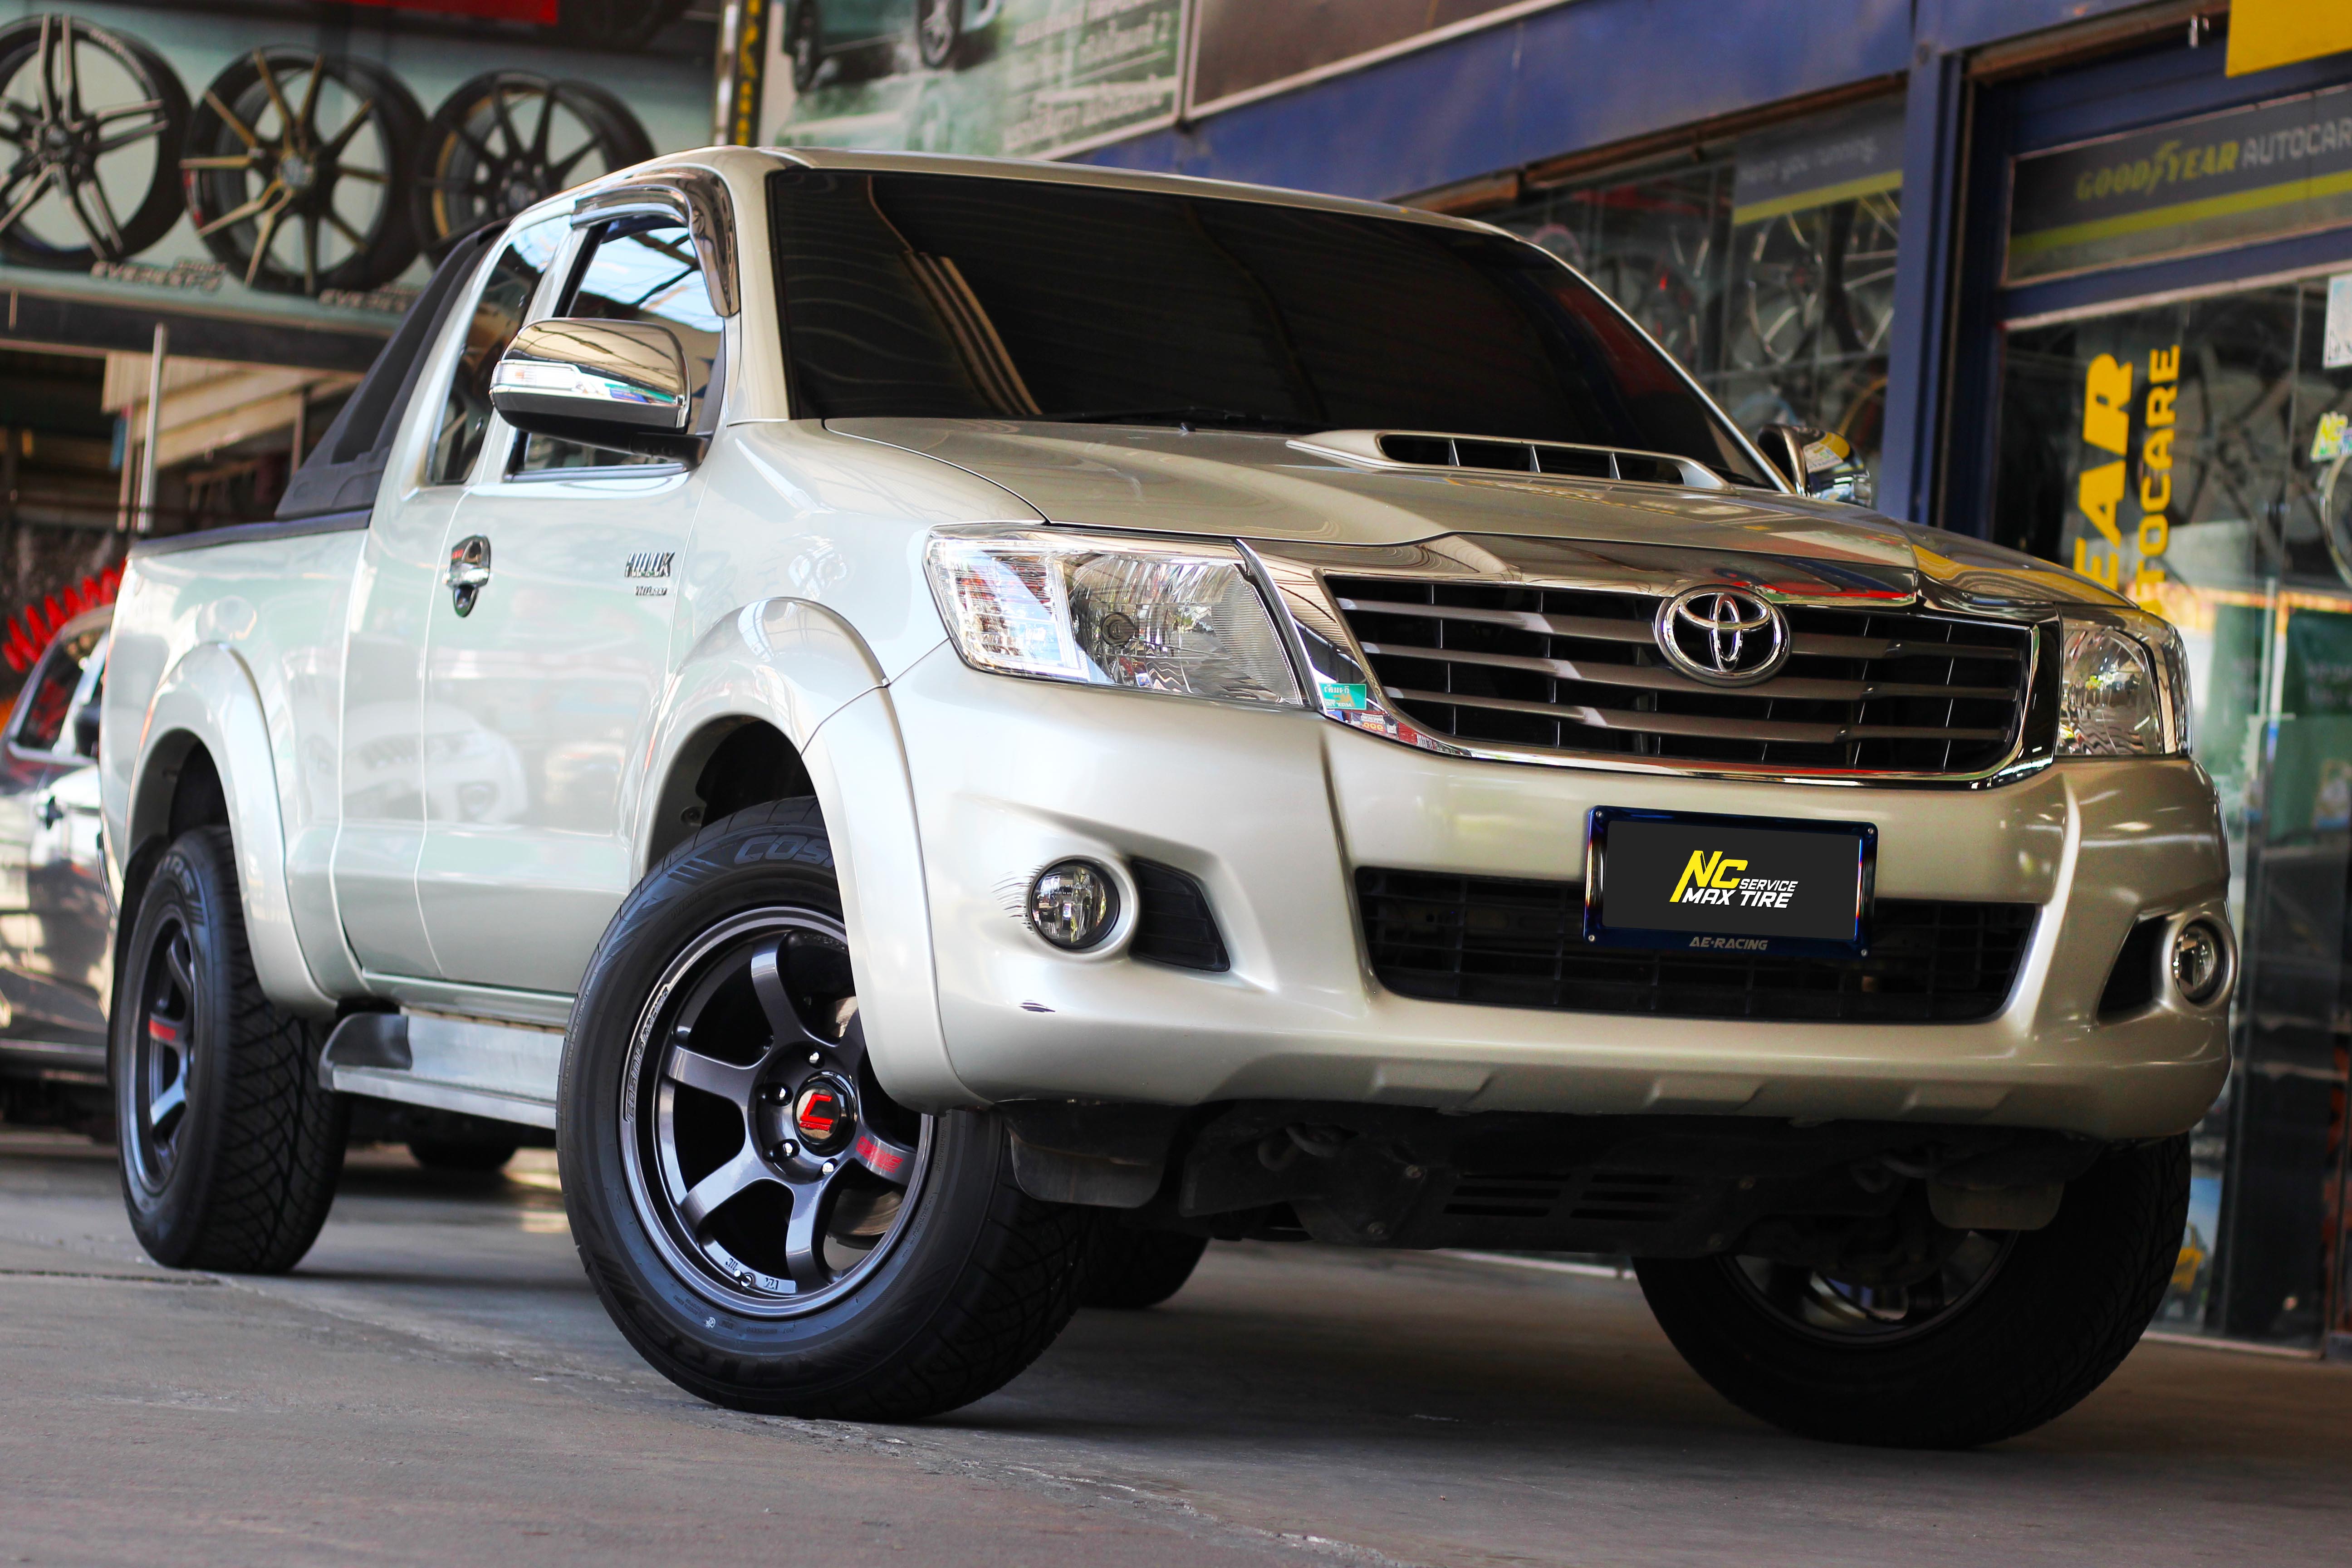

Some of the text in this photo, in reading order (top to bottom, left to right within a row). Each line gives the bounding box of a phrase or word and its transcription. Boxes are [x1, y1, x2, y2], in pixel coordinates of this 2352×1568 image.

[2075, 140, 2240, 201] GOODYEAR
[734, 834, 835, 868] COS
[1669, 850, 1798, 902] NC SERVICE
[1682, 887, 1793, 908] MAX TIRE
[642, 986, 668, 1043] RACING
